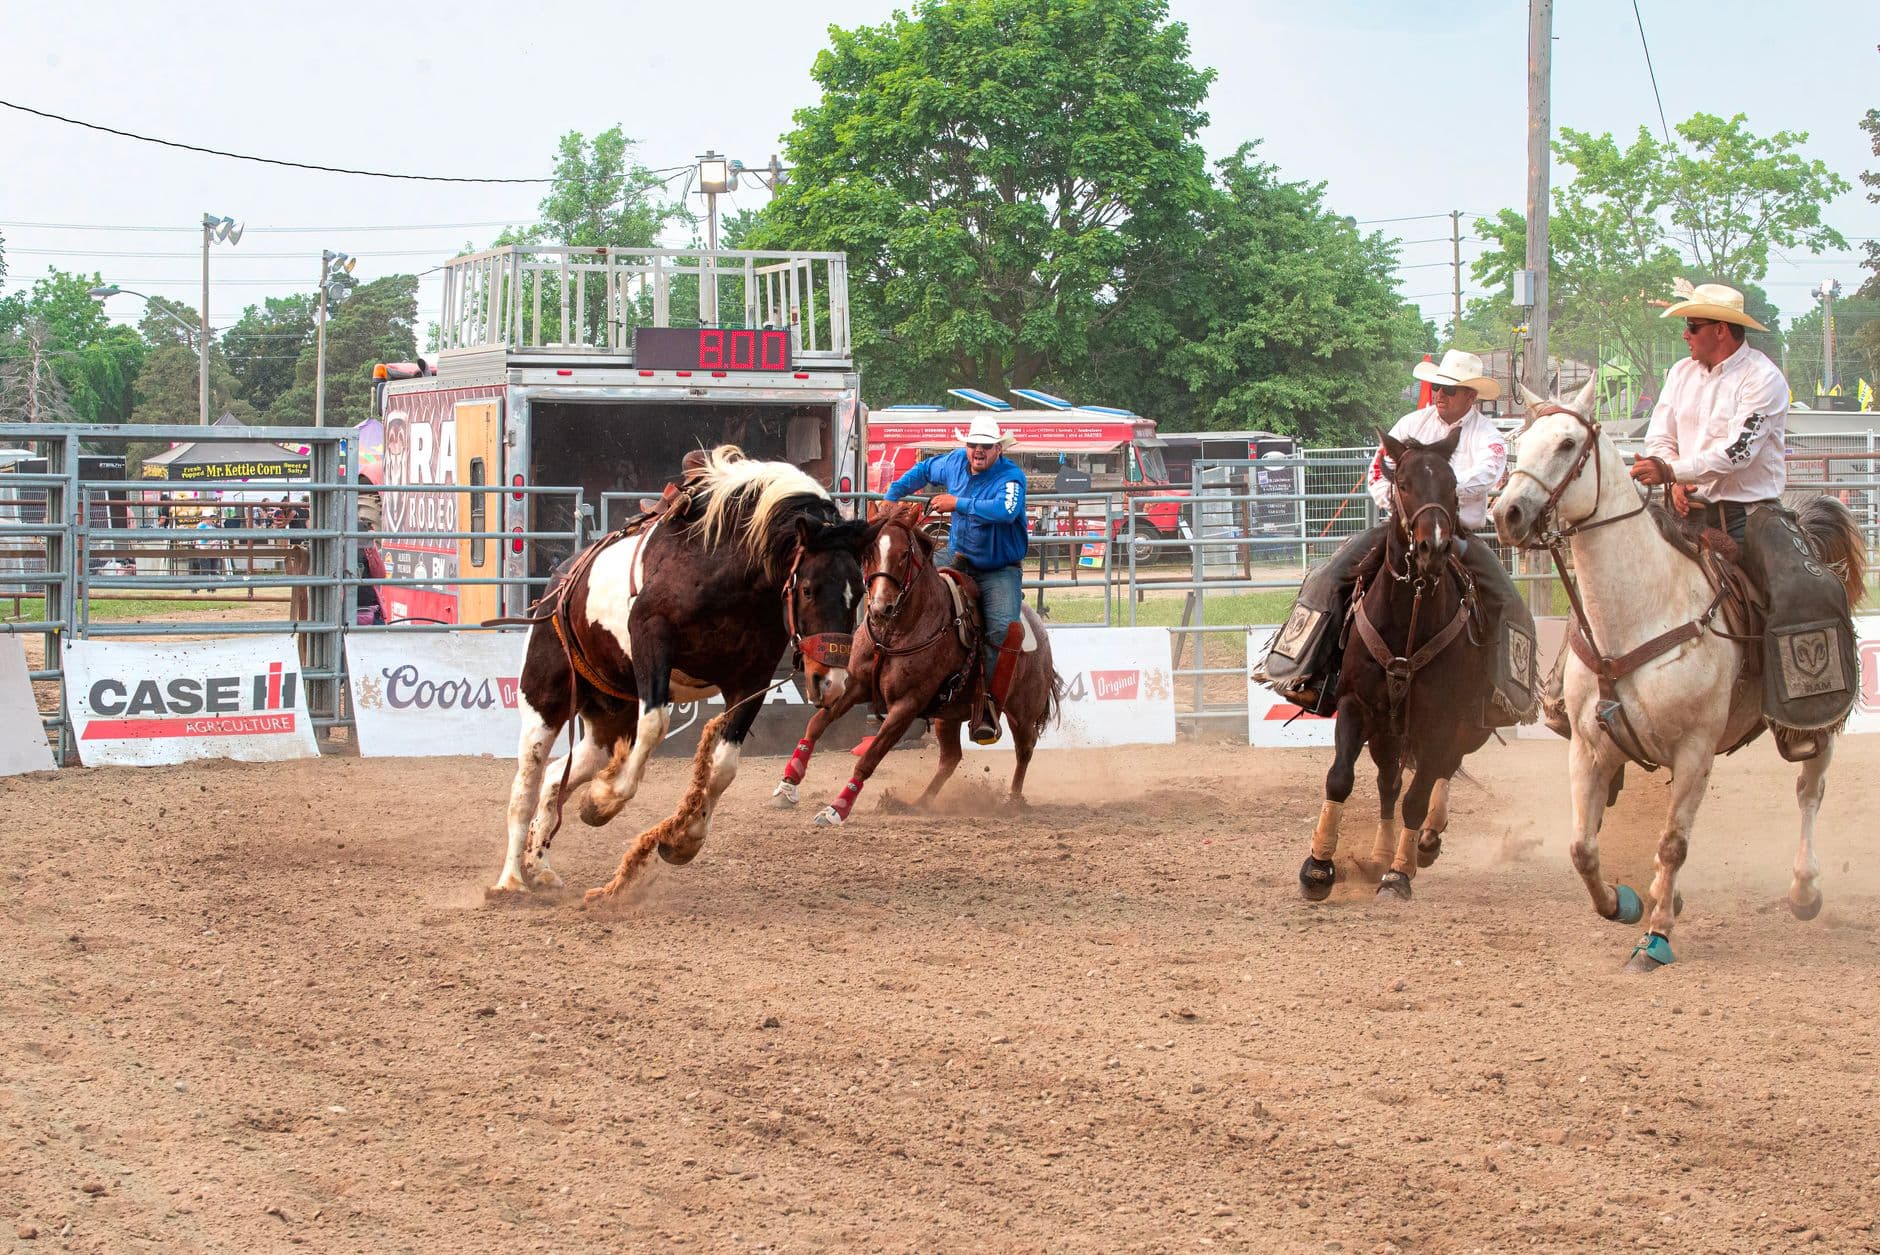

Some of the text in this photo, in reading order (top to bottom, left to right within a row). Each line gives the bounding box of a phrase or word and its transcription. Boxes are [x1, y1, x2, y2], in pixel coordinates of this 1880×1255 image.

[206, 462, 282, 478] Mr. Kettle Corn
[409, 497, 454, 531] RODEO
[88, 677, 241, 717] CASE
[381, 664, 497, 710] Coors
[1097, 671, 1137, 698] Original
[185, 717, 291, 734] AGRICULTURE
